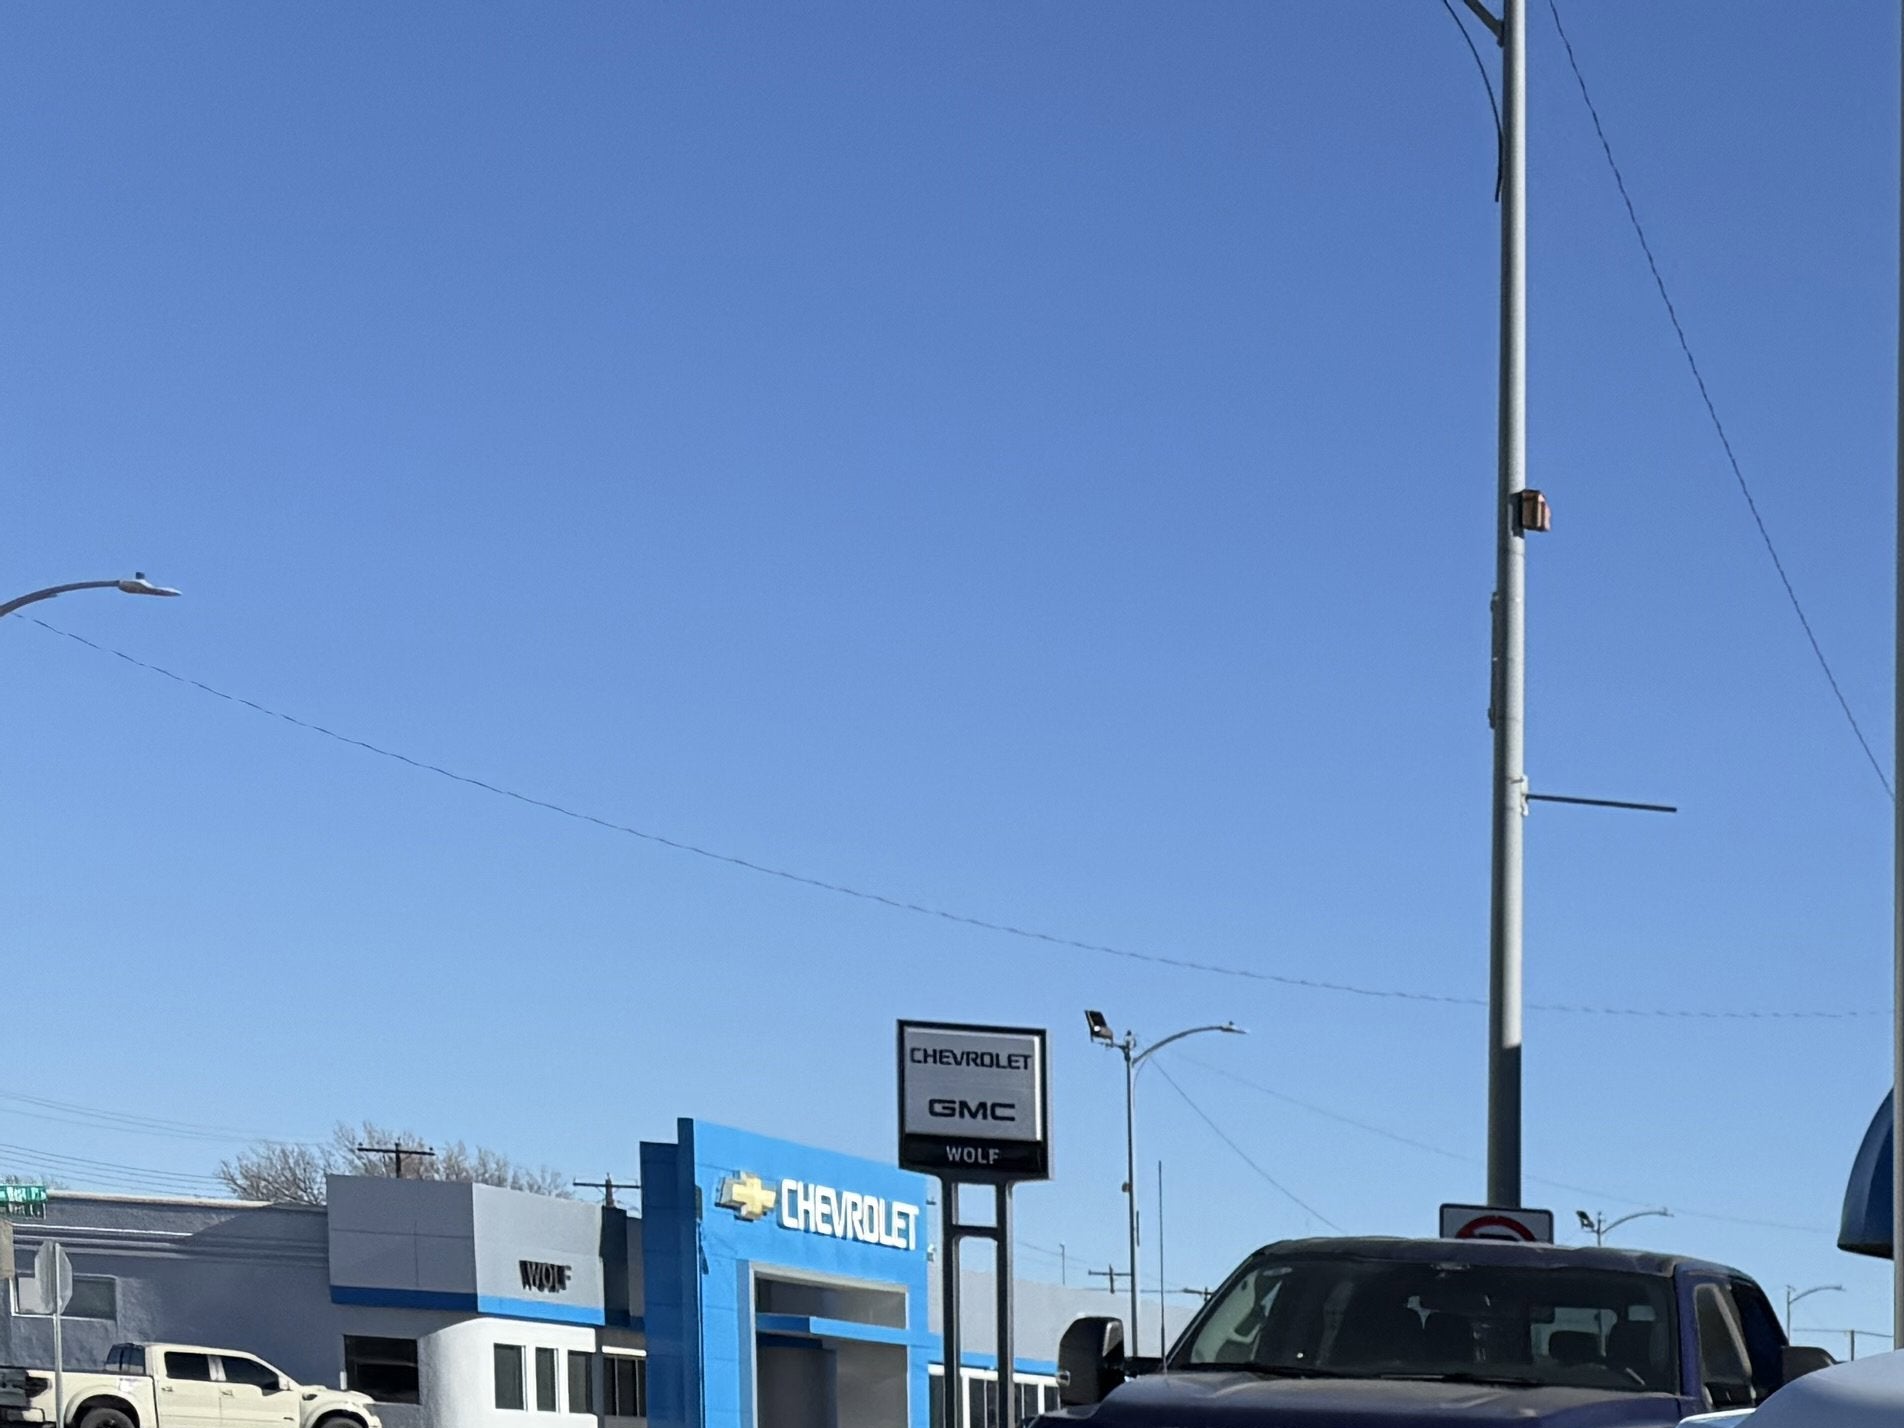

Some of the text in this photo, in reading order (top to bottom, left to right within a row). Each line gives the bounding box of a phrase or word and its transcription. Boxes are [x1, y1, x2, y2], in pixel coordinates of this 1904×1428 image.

[909, 1046, 1032, 1071] CHEVROLET
[928, 1098, 1016, 1122] GMC
[946, 1144, 1000, 1165] WOLF
[780, 1178, 920, 1251] CHEVROLET
[519, 1259, 572, 1294] WOLF
